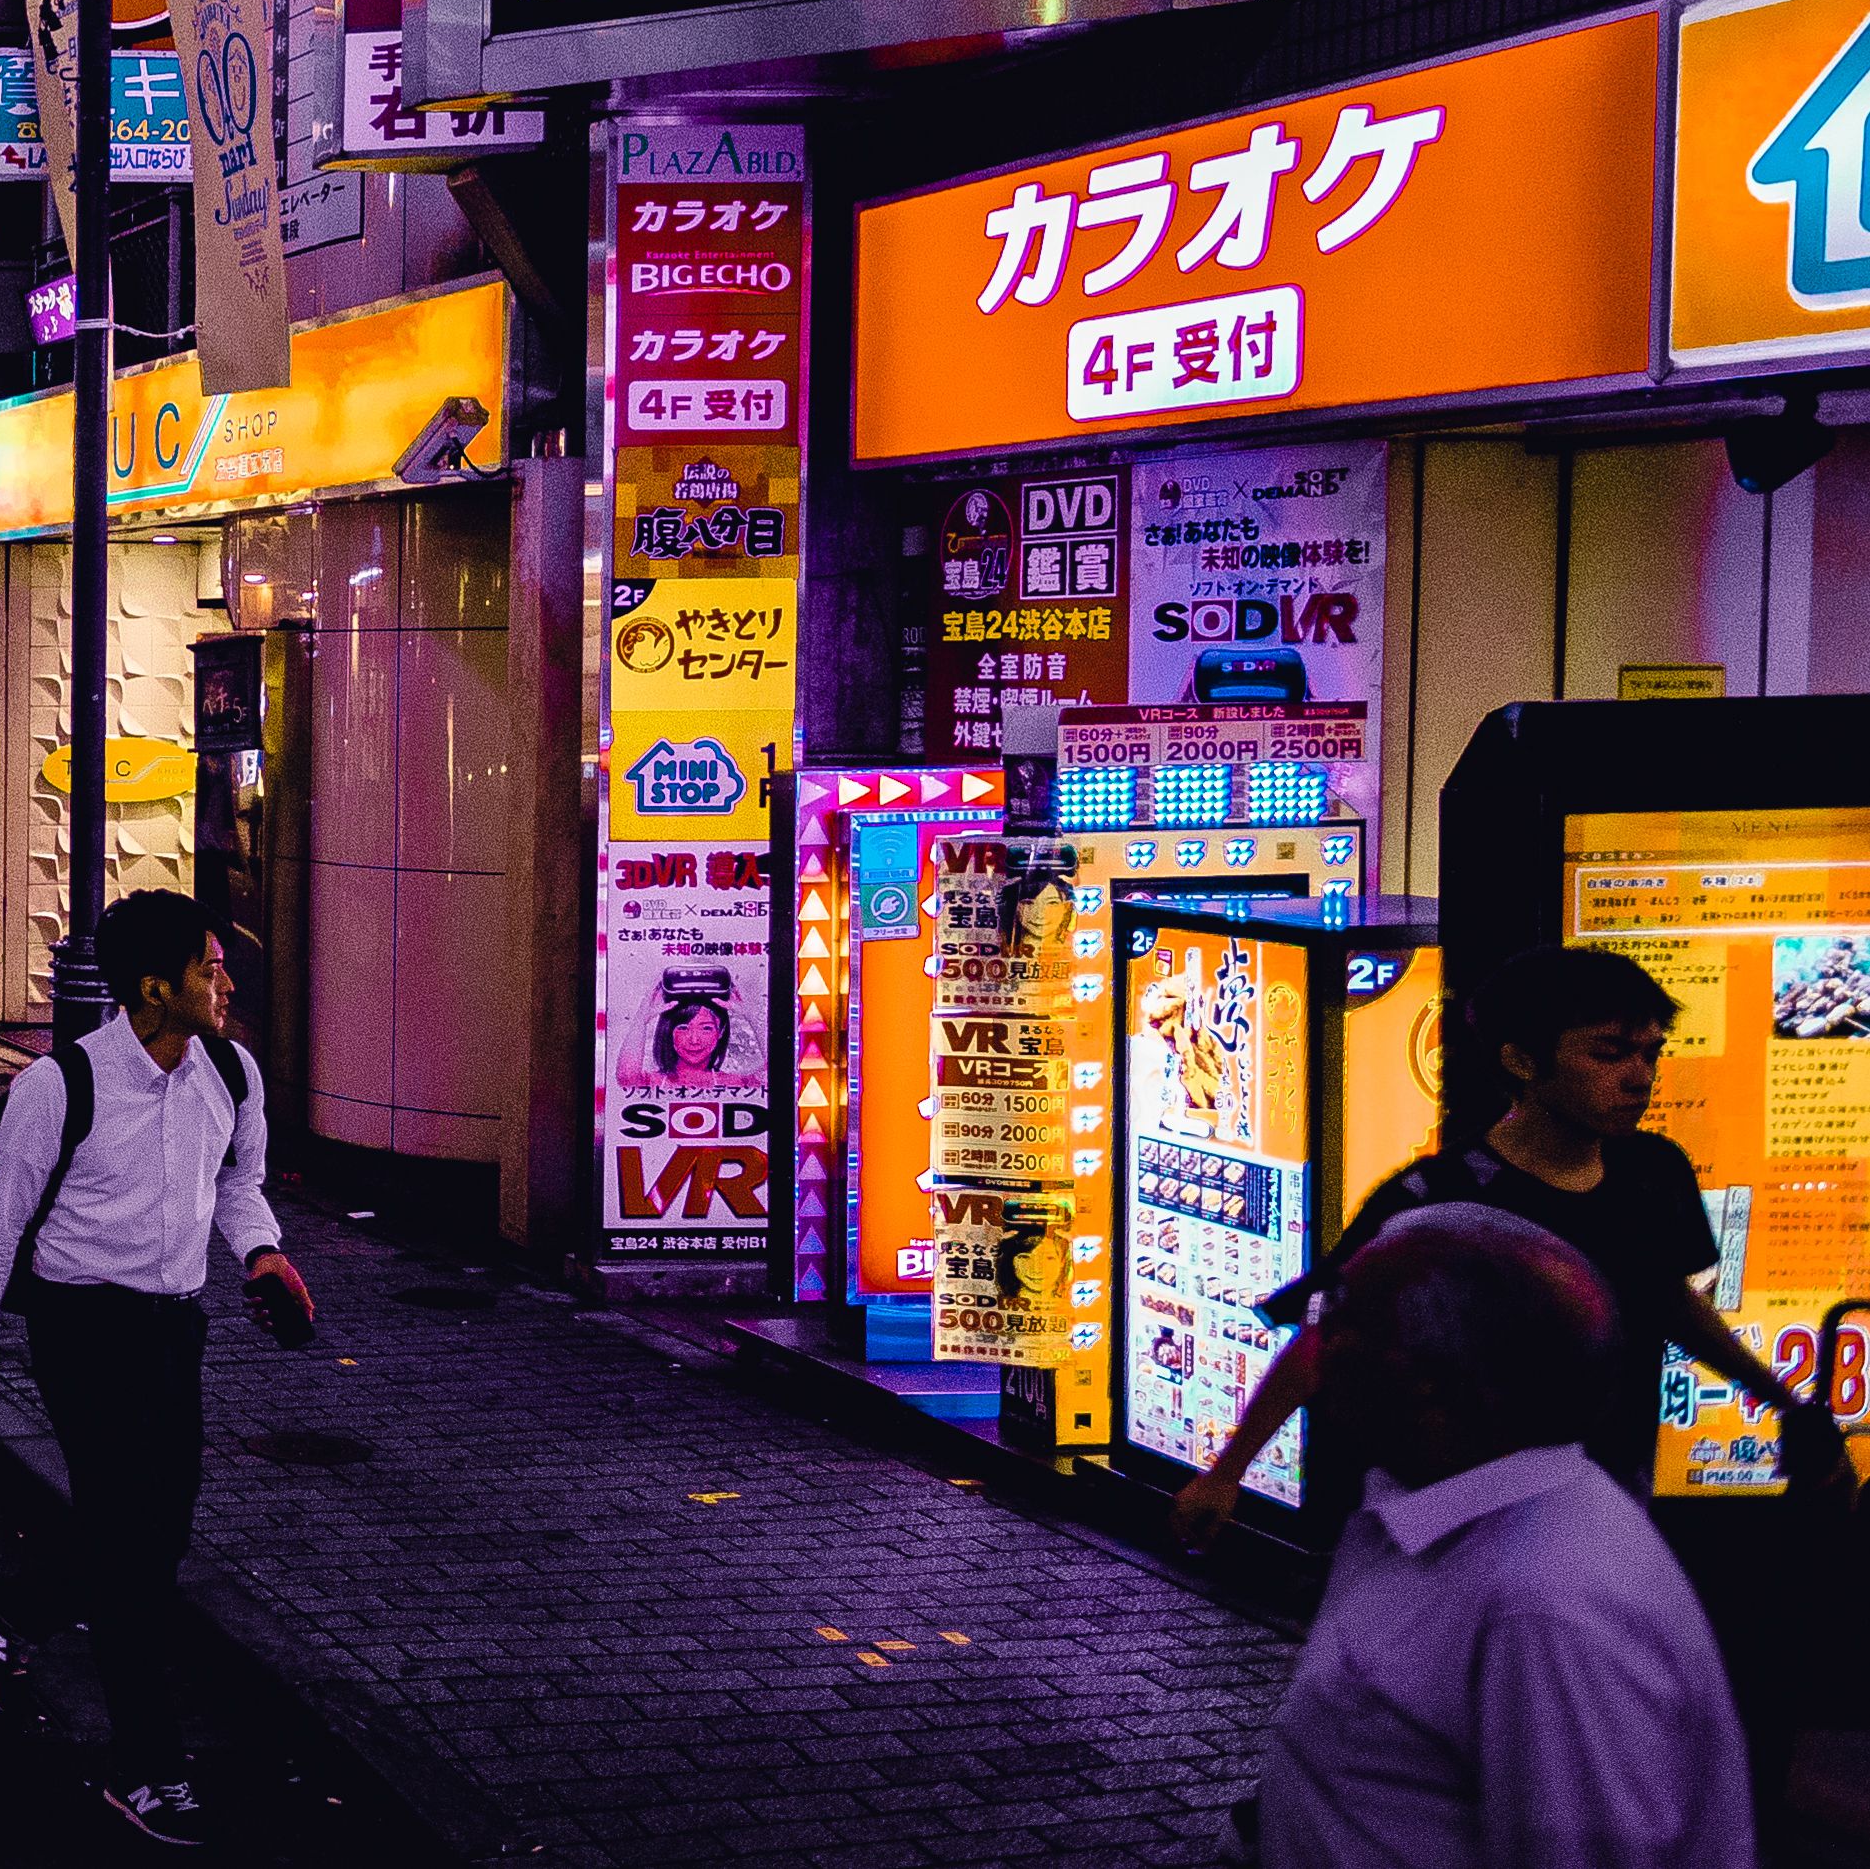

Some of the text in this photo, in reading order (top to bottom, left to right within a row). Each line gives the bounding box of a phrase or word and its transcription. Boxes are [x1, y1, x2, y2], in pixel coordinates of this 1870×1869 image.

[275, 35, 287, 54] 4F
[274, 119, 286, 139] 2F
[632, 200, 788, 232] カラオケ
[976, 104, 1447, 315] カラオケ
[646, 250, 775, 259] Karaoke Entertainment
[632, 263, 791, 291] BIG ECHO
[630, 330, 786, 361] カラオケ
[223, 409, 279, 444] SHOP
[683, 463, 730, 480] 伝説の
[1029, 484, 1113, 530] DVD
[630, 507, 785, 559] 腹八分目
[1025, 543, 1111, 593] 鑑賞
[1202, 539, 1370, 572] 未知の映像体験を!
[614, 585, 644, 606] 2F
[675, 608, 783, 641] やきとり
[942, 607, 1111, 642] 宝島24渋谷本店
[677, 648, 788, 680] センター
[978, 653, 1067, 681] 全室防音
[1139, 707, 1198, 720] VRコース
[1064, 741, 1150, 764] 1500円
[1167, 739, 1258, 761] 2000円
[1270, 738, 1362, 761] 2500円
[654, 760, 718, 780] MINI
[651, 783, 720, 803] STOP
[616, 853, 698, 890] 3DVR
[941, 843, 1007, 874] VR
[948, 906, 998, 929] 宝島
[1132, 931, 1153, 951] 2F
[1348, 956, 1394, 992] 2F
[942, 1021, 1012, 1055] VR
[1019, 1037, 1065, 1056] 宝島
[958, 1059, 1049, 1079] VRコース
[961, 1091, 995, 1106] 60分
[620, 1102, 769, 1139] SOD
[961, 1124, 994, 1139] 90分
[961, 1149, 997, 1164] 2時間
[616, 1145, 769, 1219] VR
[937, 1193, 1004, 1226] VR
[611, 1237, 768, 1250] 宝島24 渋谷本店 受付B1
[946, 1257, 995, 1281] 宝島
